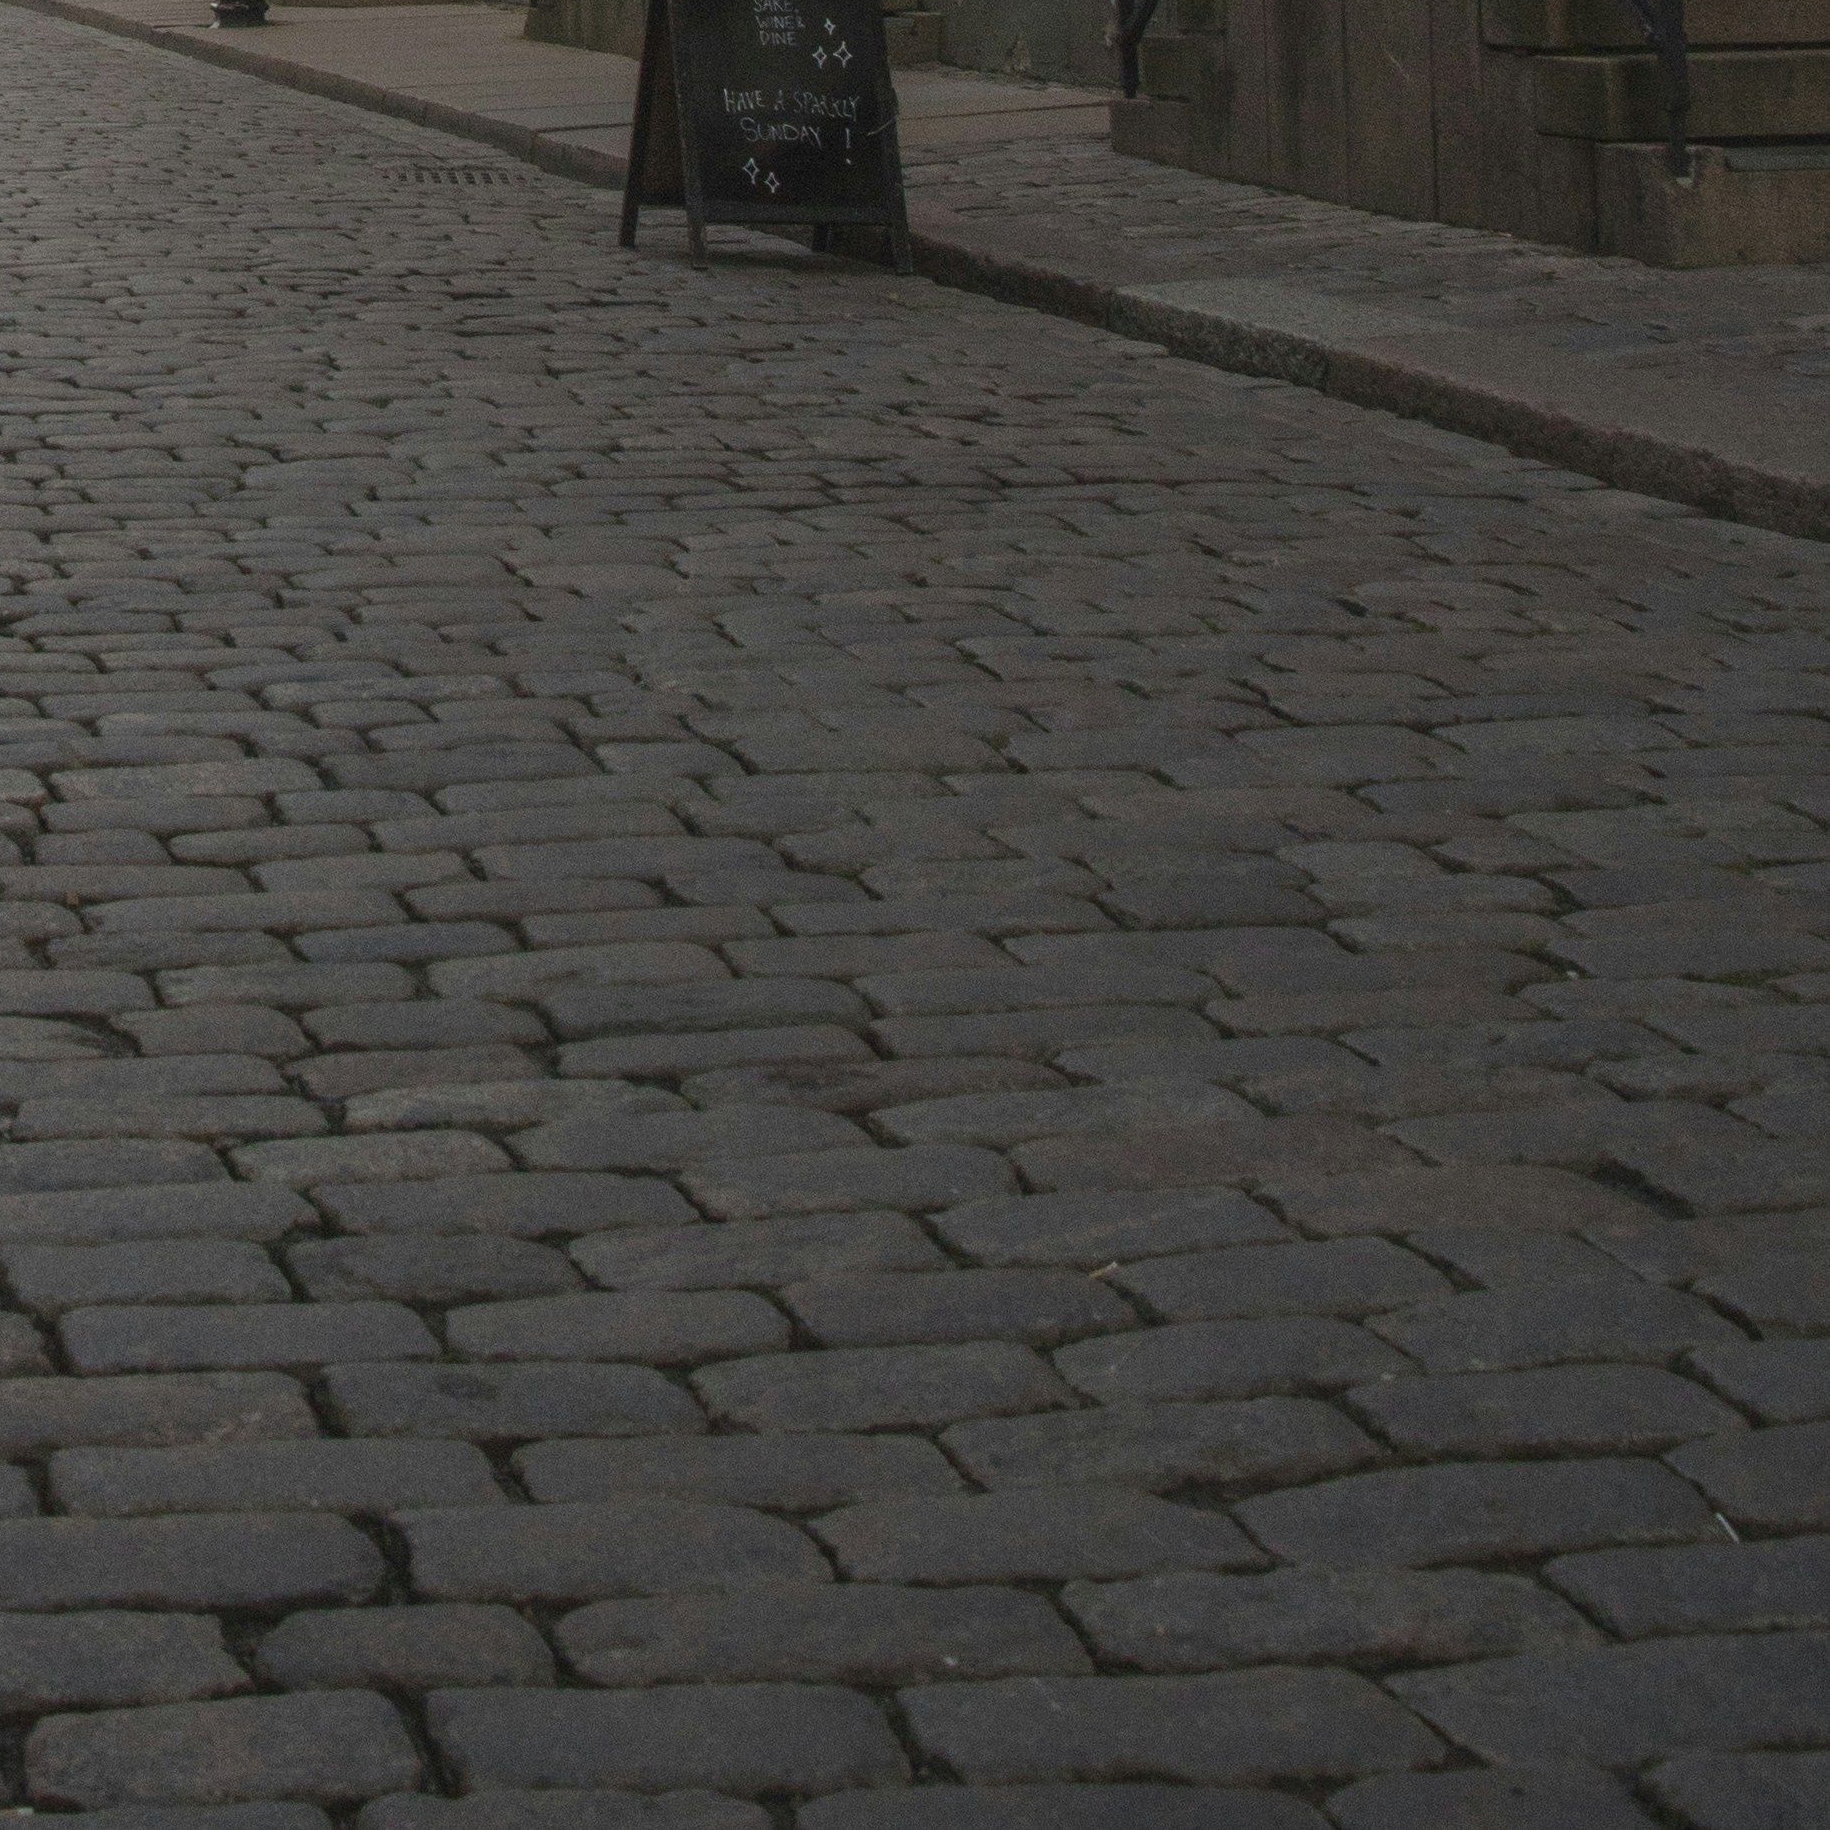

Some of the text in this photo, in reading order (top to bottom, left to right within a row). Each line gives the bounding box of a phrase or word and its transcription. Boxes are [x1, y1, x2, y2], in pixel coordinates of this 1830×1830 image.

[759, 29, 798, 46] DINE
[723, 87, 765, 114] HAVE
[773, 88, 786, 112] A
[740, 117, 822, 147] SUNDAY
